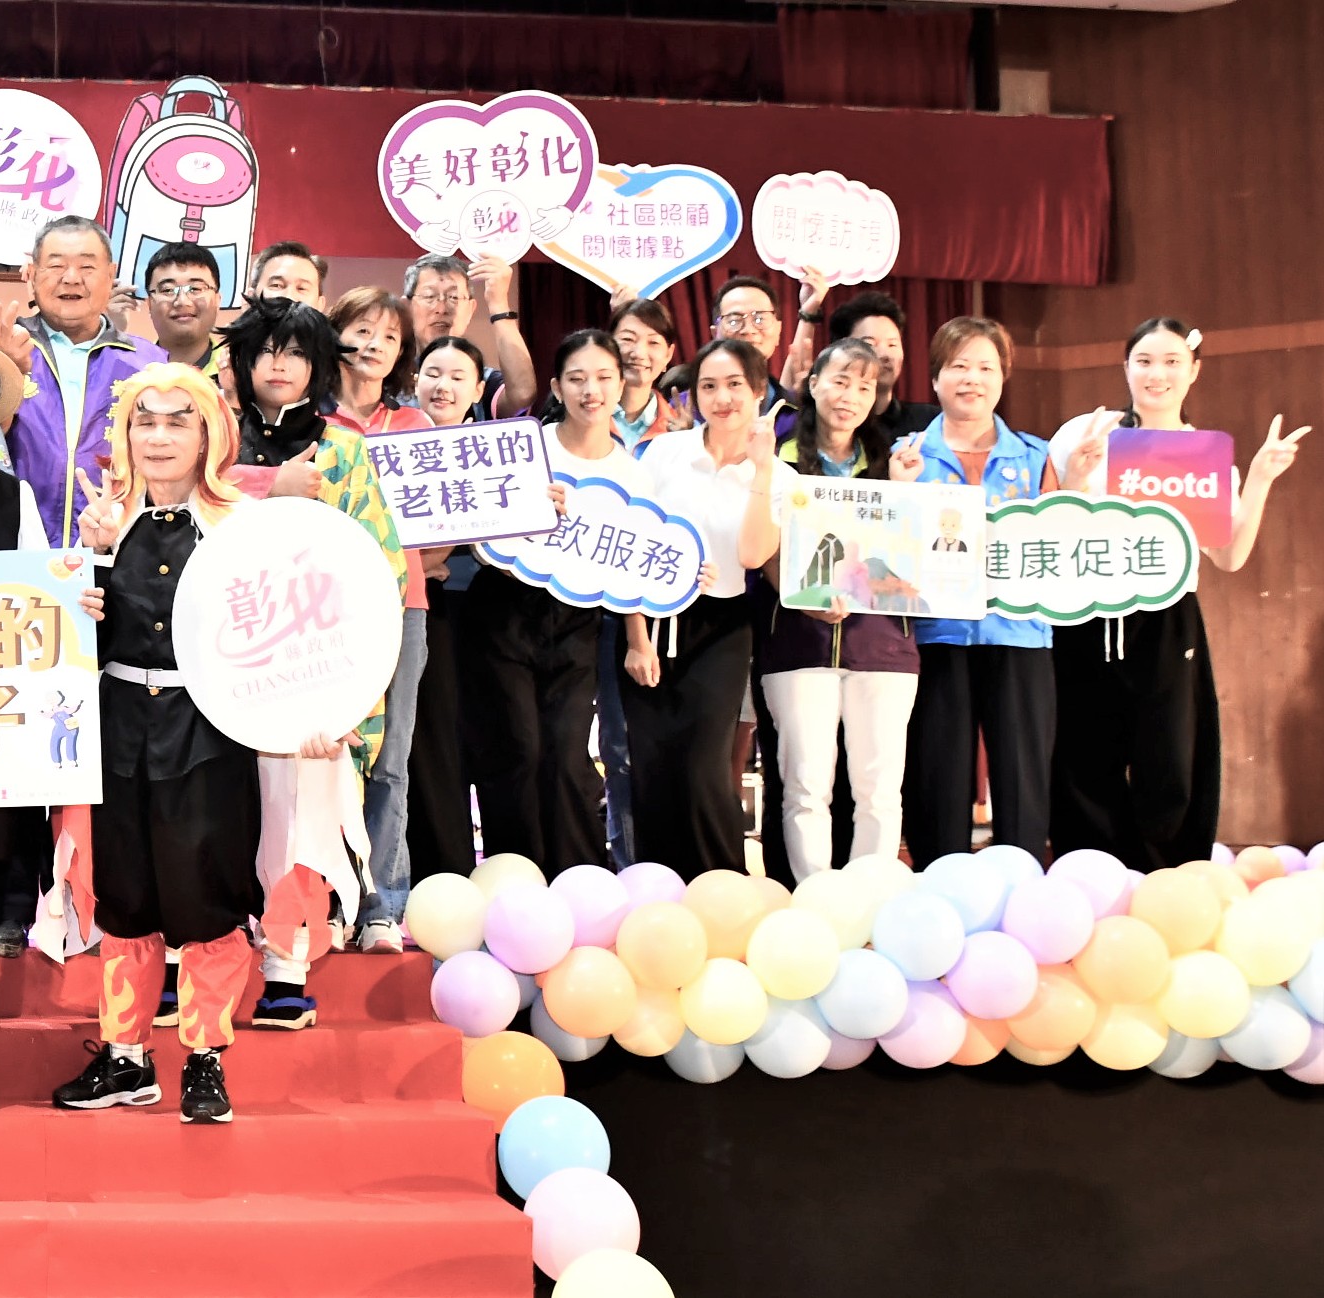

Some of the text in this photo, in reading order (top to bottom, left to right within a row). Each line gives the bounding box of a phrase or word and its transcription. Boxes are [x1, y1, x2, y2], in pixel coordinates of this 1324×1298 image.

[393, 131, 580, 197] 美好彰化
[473, 201, 518, 233] 彰化
[607, 203, 709, 226] 社區照顧
[582, 235, 684, 259] 關懷據點
[368, 430, 534, 478] 我愛我的
[393, 474, 521, 519] 老樣子
[814, 487, 883, 505] 彰化縣長青
[1118, 469, 1218, 499] #ootd
[857, 507, 897, 522] 幸福卡
[523, 513, 685, 586] 飲服務
[225, 548, 340, 640] 彰化
